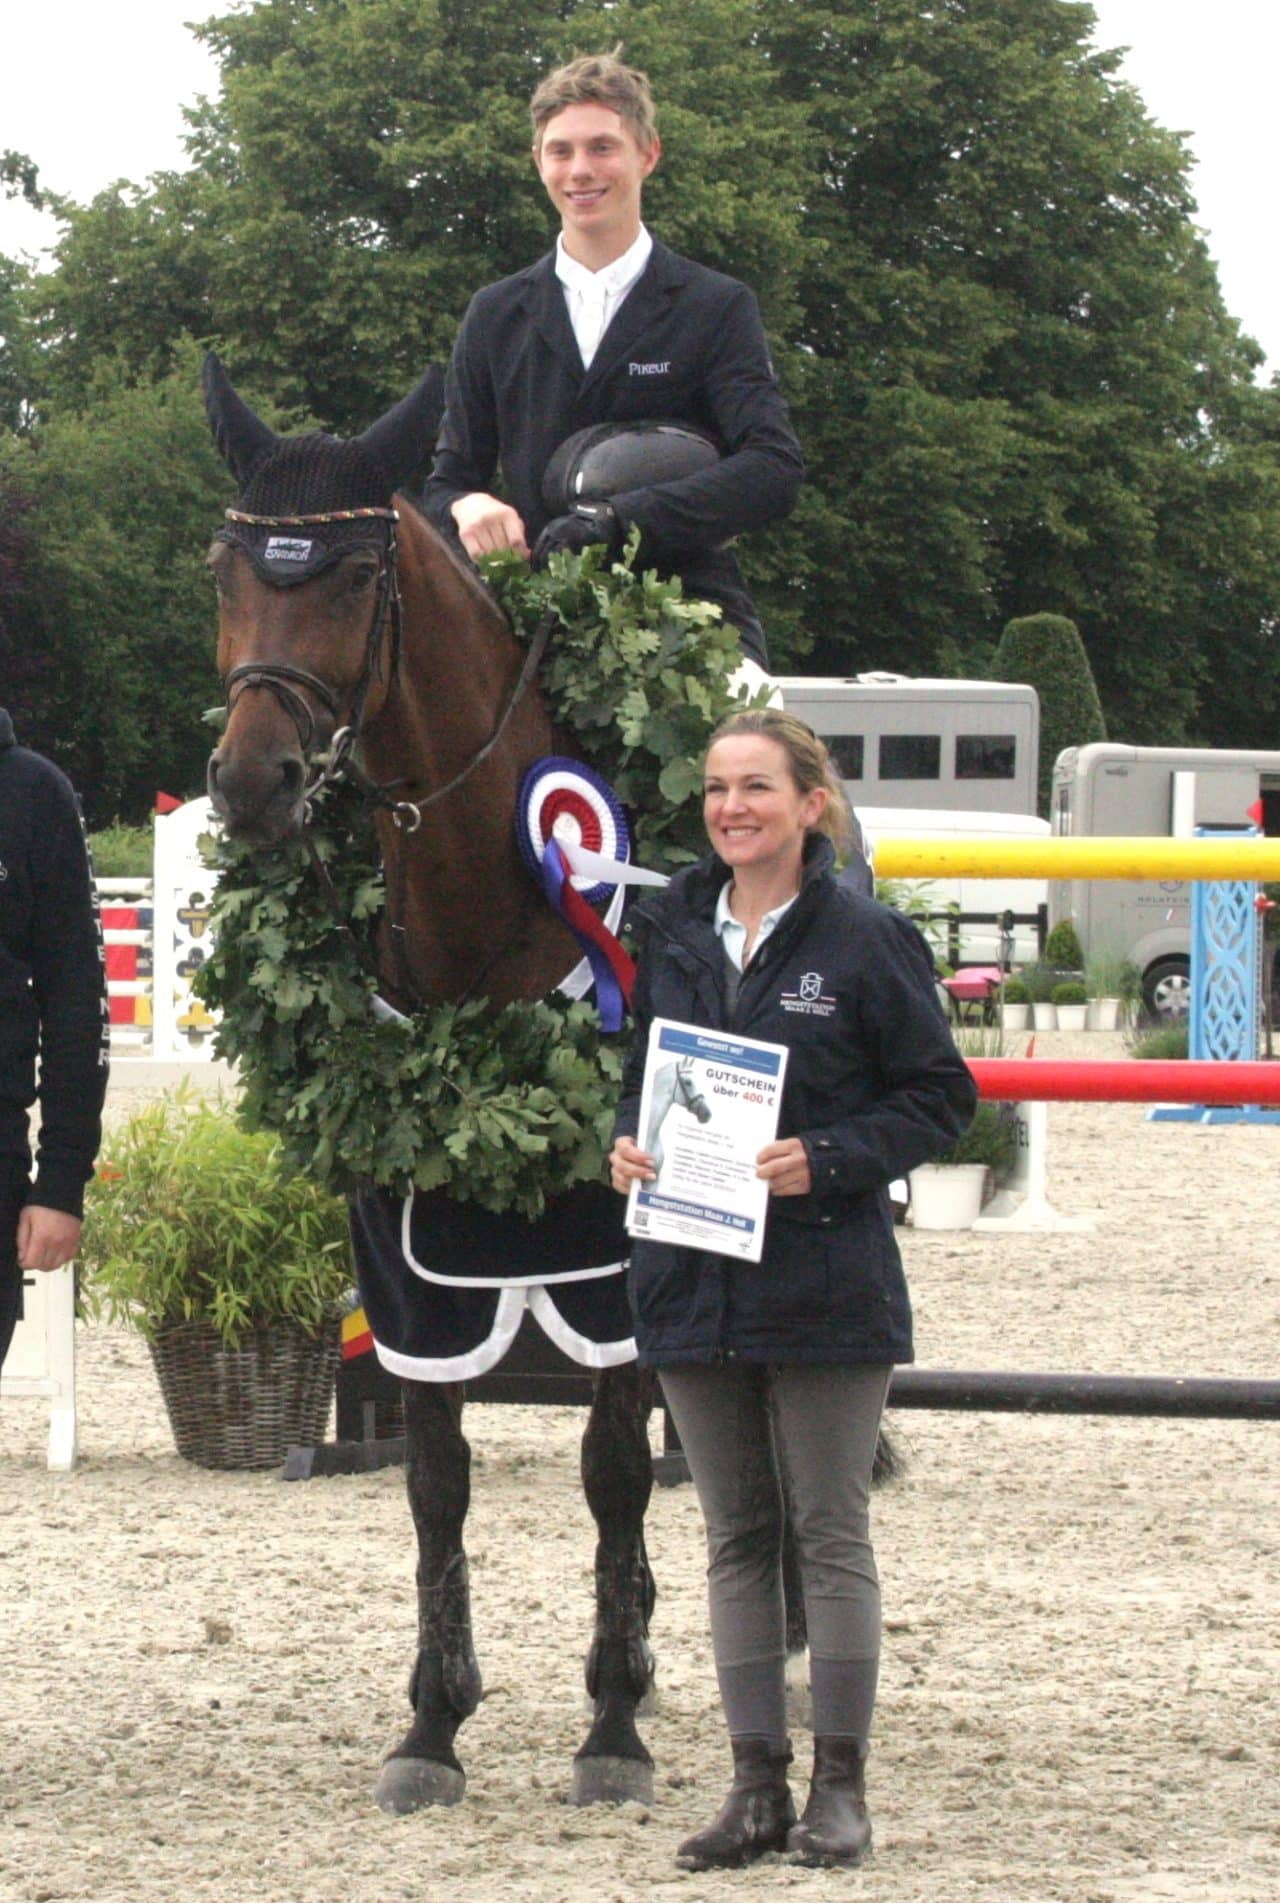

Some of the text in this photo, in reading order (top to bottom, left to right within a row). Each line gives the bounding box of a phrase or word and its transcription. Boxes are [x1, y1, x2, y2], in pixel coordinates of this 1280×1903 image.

[706, 1068, 776, 1093] GUTSCHEIN
[713, 1083, 739, 1099] über
[742, 1092, 764, 1105] 400
